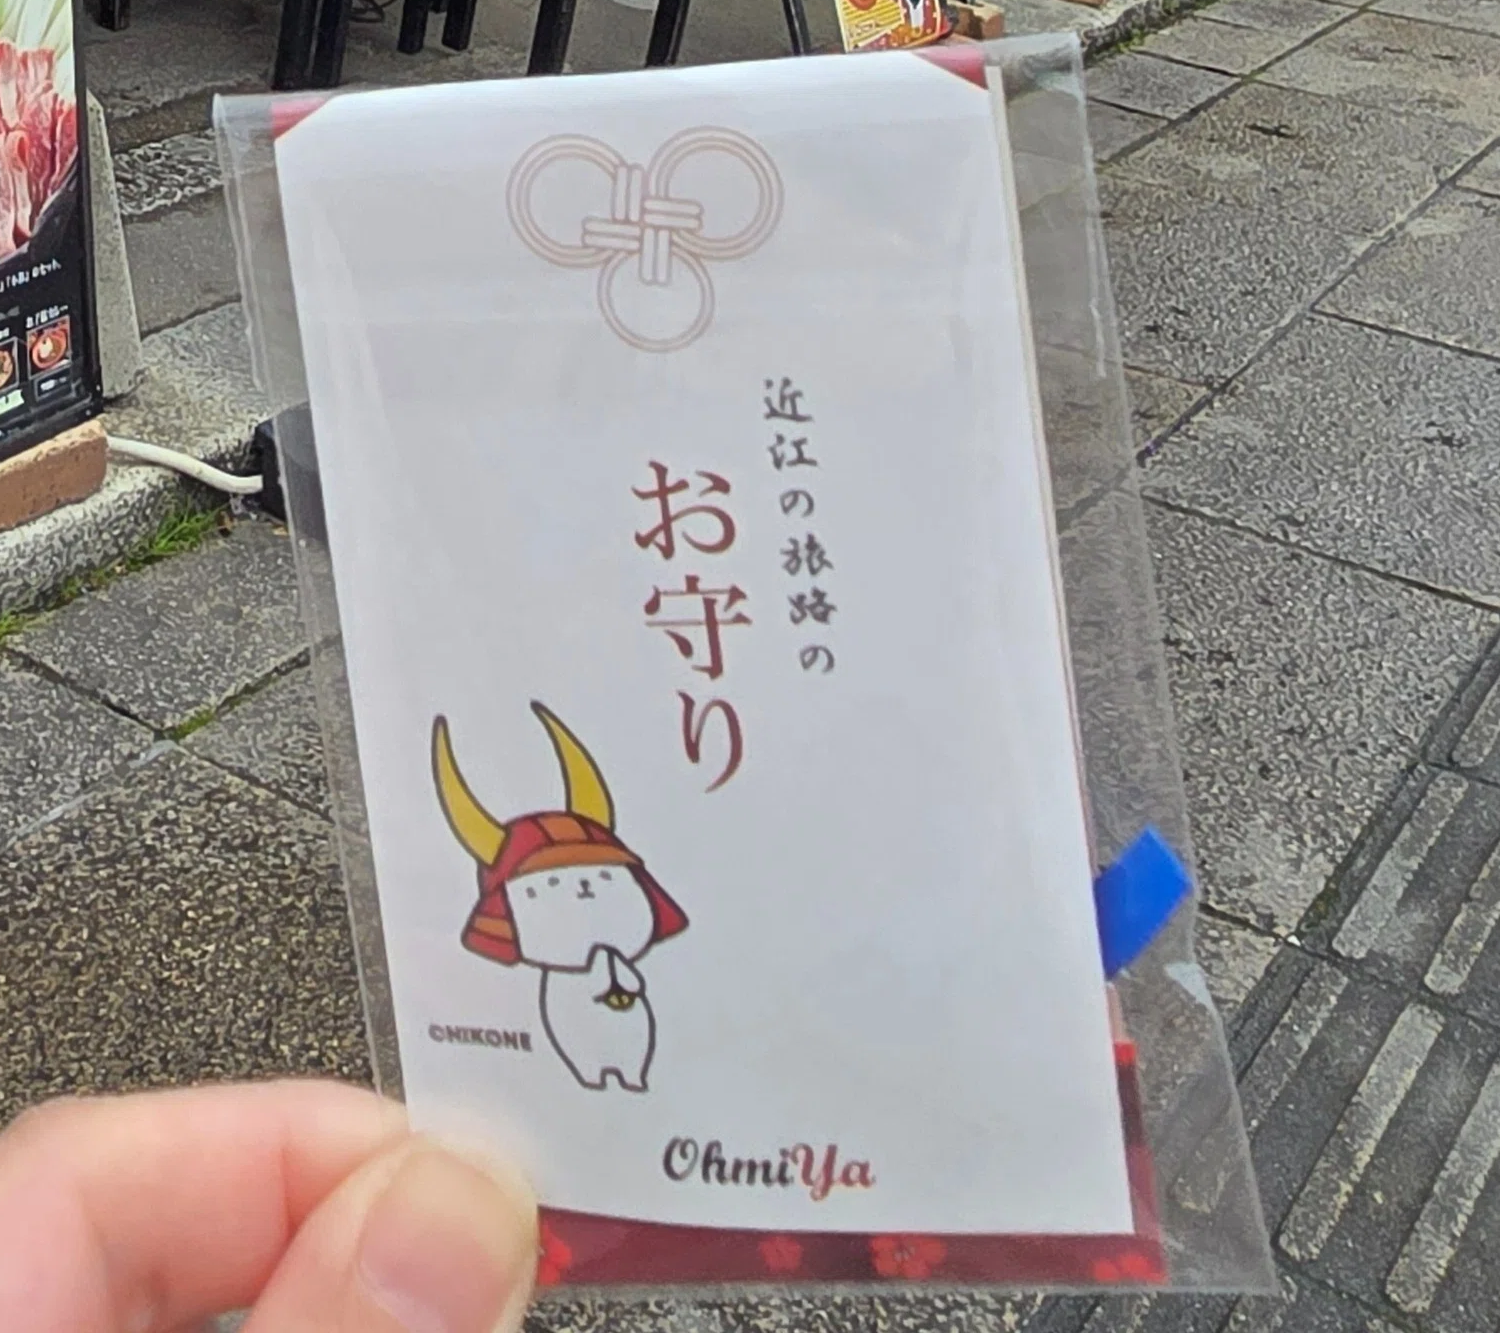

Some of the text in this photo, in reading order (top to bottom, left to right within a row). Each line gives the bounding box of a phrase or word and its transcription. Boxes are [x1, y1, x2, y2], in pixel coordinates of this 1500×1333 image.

[631, 459, 754, 793] お守り
[764, 376, 838, 674] 近江の旅路の
[661, 1136, 876, 1201] OhmiYa
